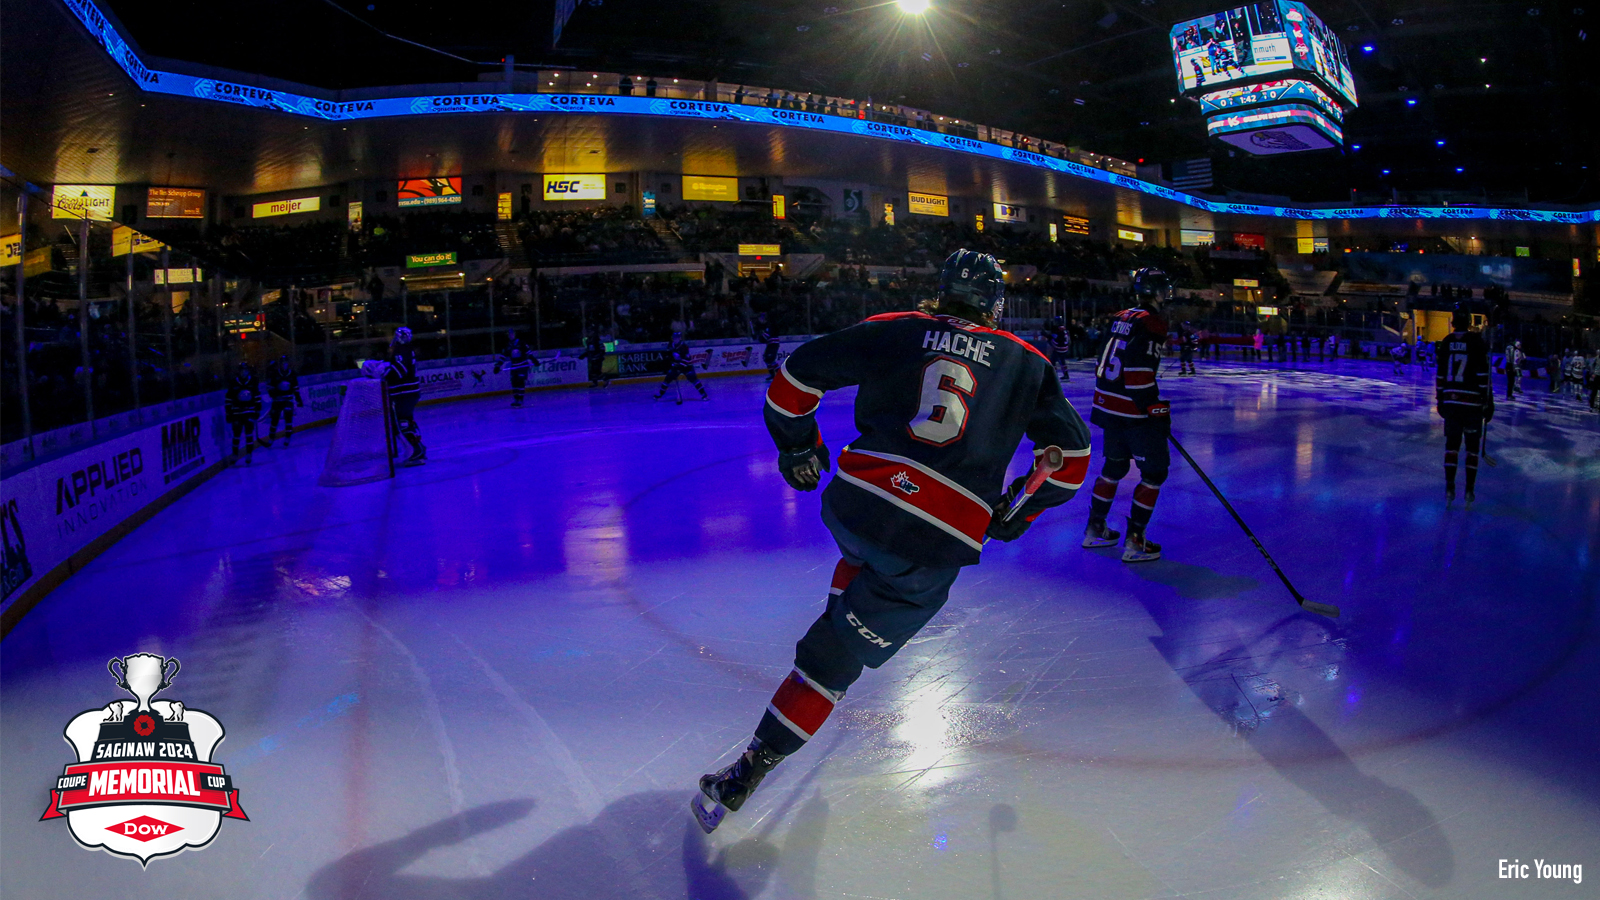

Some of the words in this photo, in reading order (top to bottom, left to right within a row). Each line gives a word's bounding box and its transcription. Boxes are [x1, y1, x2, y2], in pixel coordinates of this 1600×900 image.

[214, 82, 274, 102] CORTEVA
[432, 95, 500, 107] CORTEVA
[551, 95, 615, 106] CORTEVA
[1240, 95, 1257, 104] 1:42
[315, 101, 374, 114] CORTEVA
[670, 101, 729, 113] CORTEVA
[771, 109, 825, 124] CORTEVA
[867, 122, 912, 137] CORTEVA
[944, 135, 983, 149] CORTEVA
[1013, 150, 1046, 163] CORTEVA
[1067, 162, 1096, 175] CORTEVA
[546, 180, 580, 194] HSC
[271, 200, 302, 214] meijer
[911, 195, 926, 204] BUD
[926, 197, 946, 206] LIGHT
[1228, 204, 1260, 212] CORTEVA
[436, 253, 444, 261] do
[961, 268, 969, 279] 6
[922, 330, 995, 367] HACHÉ
[1146, 340, 1161, 359] 15
[617, 352, 664, 364] ISABELLA
[1097, 336, 1128, 381] 15
[617, 362, 648, 374] BANK
[1447, 353, 1468, 382] 17
[428, 372, 453, 384] LOCAL
[906, 355, 978, 447] 6
[56, 447, 144, 516] APPLIED
[57, 477, 148, 539] INNOVATION
[846, 611, 893, 649] CCM
